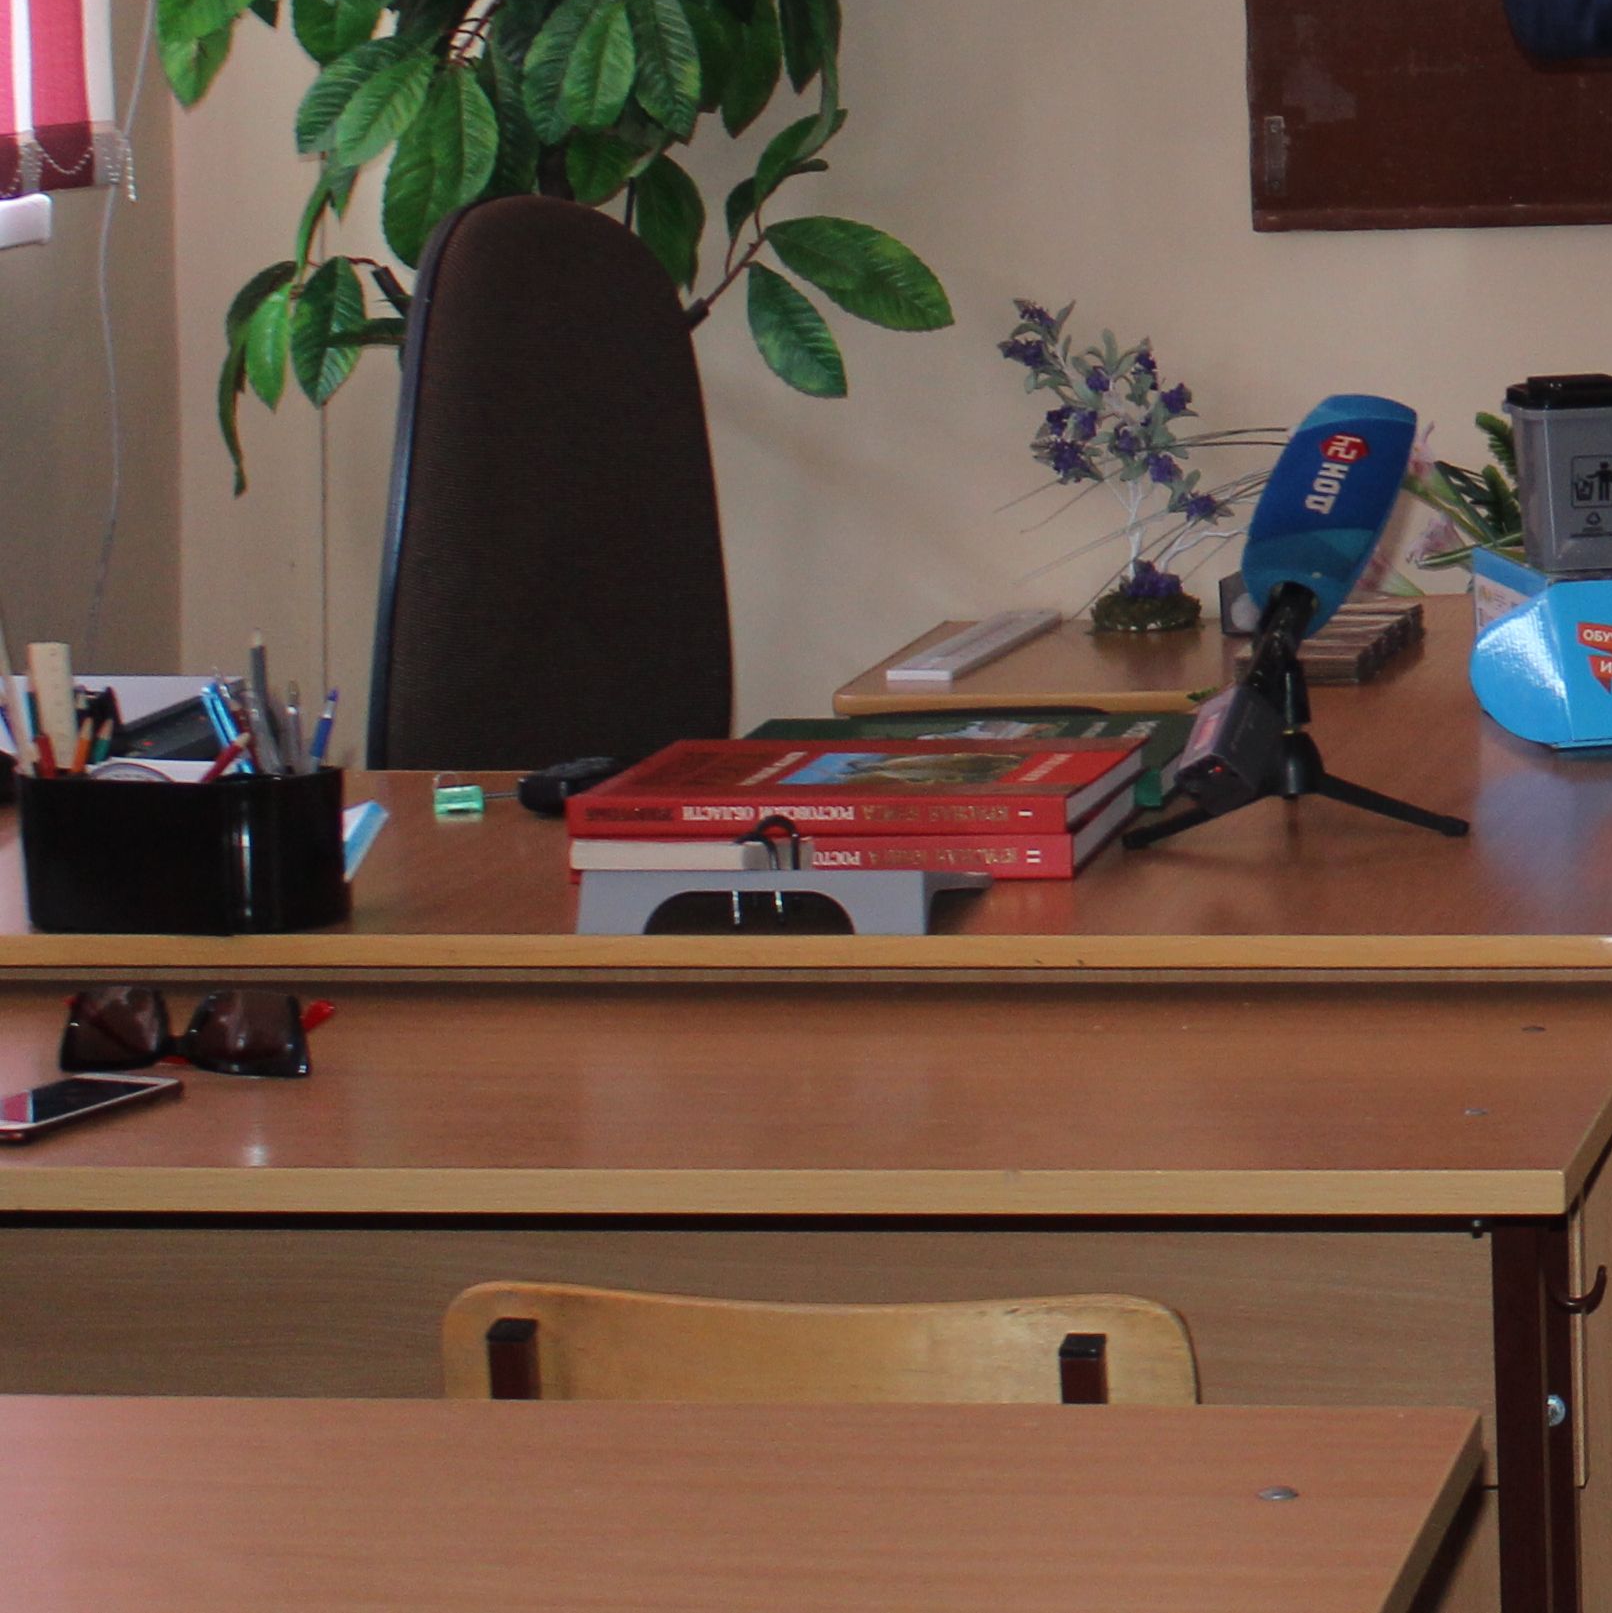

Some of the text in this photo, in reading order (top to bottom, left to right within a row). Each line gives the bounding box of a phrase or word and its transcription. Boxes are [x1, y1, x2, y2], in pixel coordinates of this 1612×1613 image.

[1304, 434, 1363, 515] ДОН 24
[813, 849, 861, 866] РОСТО
